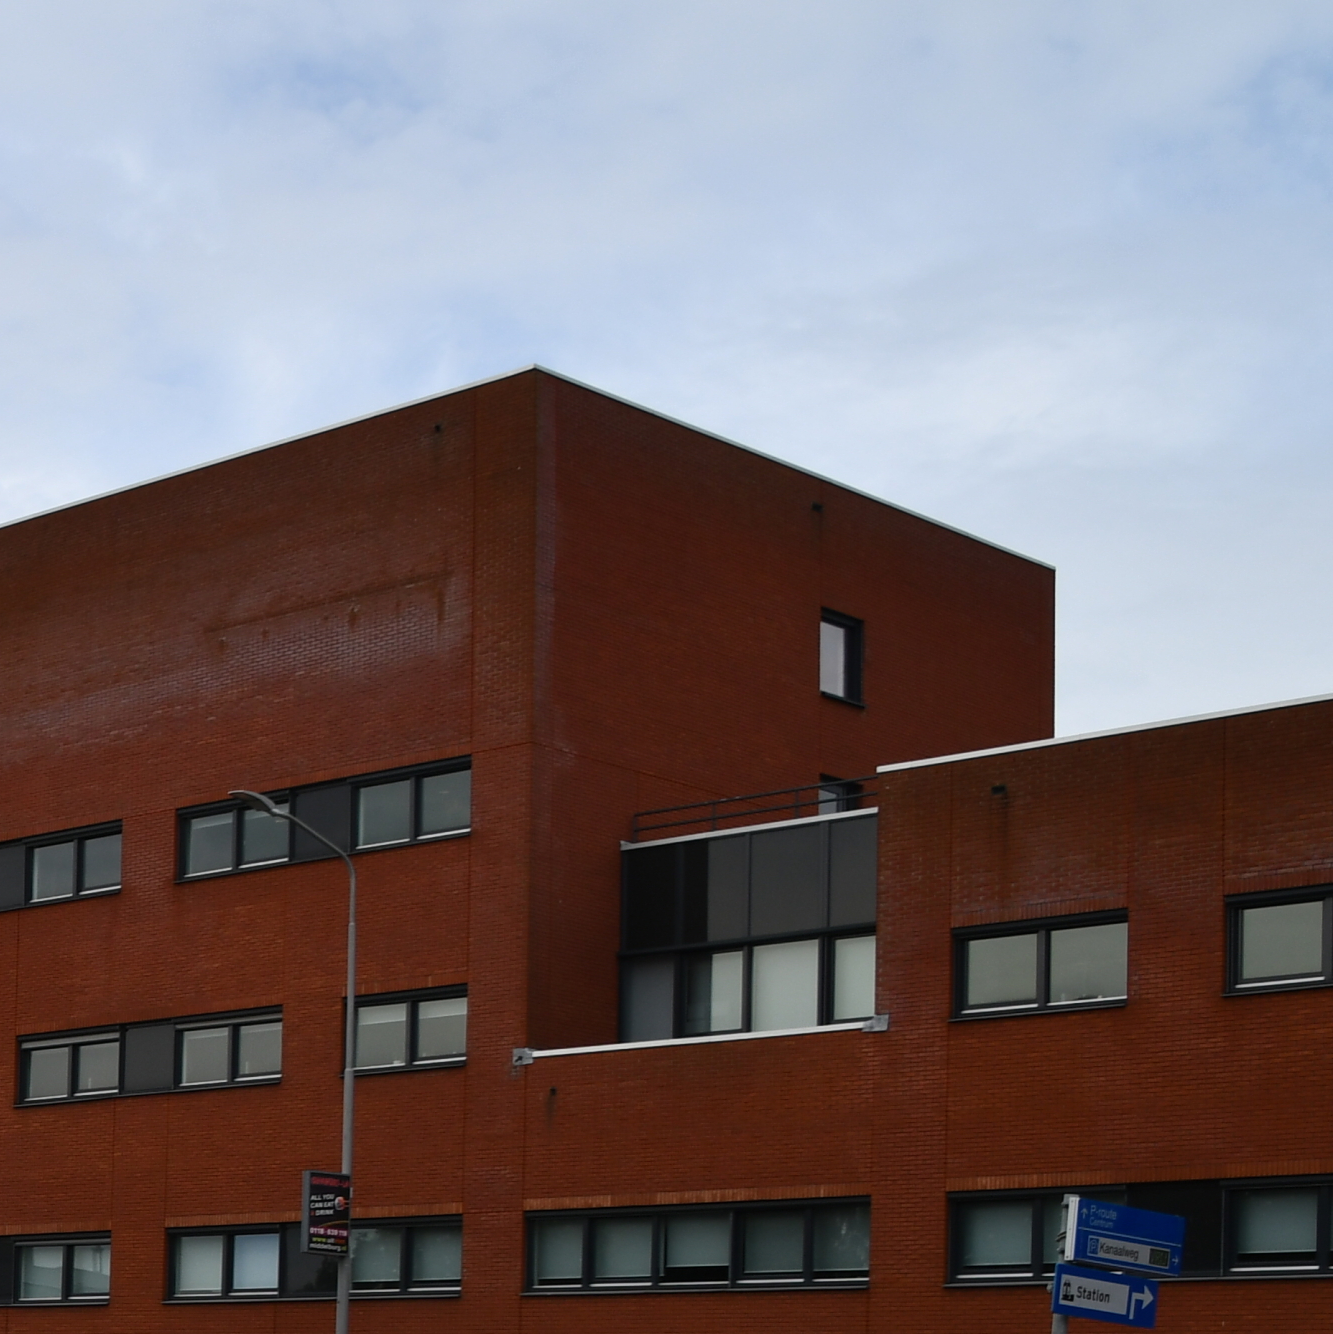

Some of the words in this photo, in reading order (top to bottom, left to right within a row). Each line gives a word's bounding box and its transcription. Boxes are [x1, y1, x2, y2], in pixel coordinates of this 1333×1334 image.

[1090, 1204, 1117, 1220] P-route
[1089, 1216, 1114, 1229] Centrum
[1099, 1241, 1140, 1262] Kanaalweg
[1076, 1285, 1110, 1304] Station
